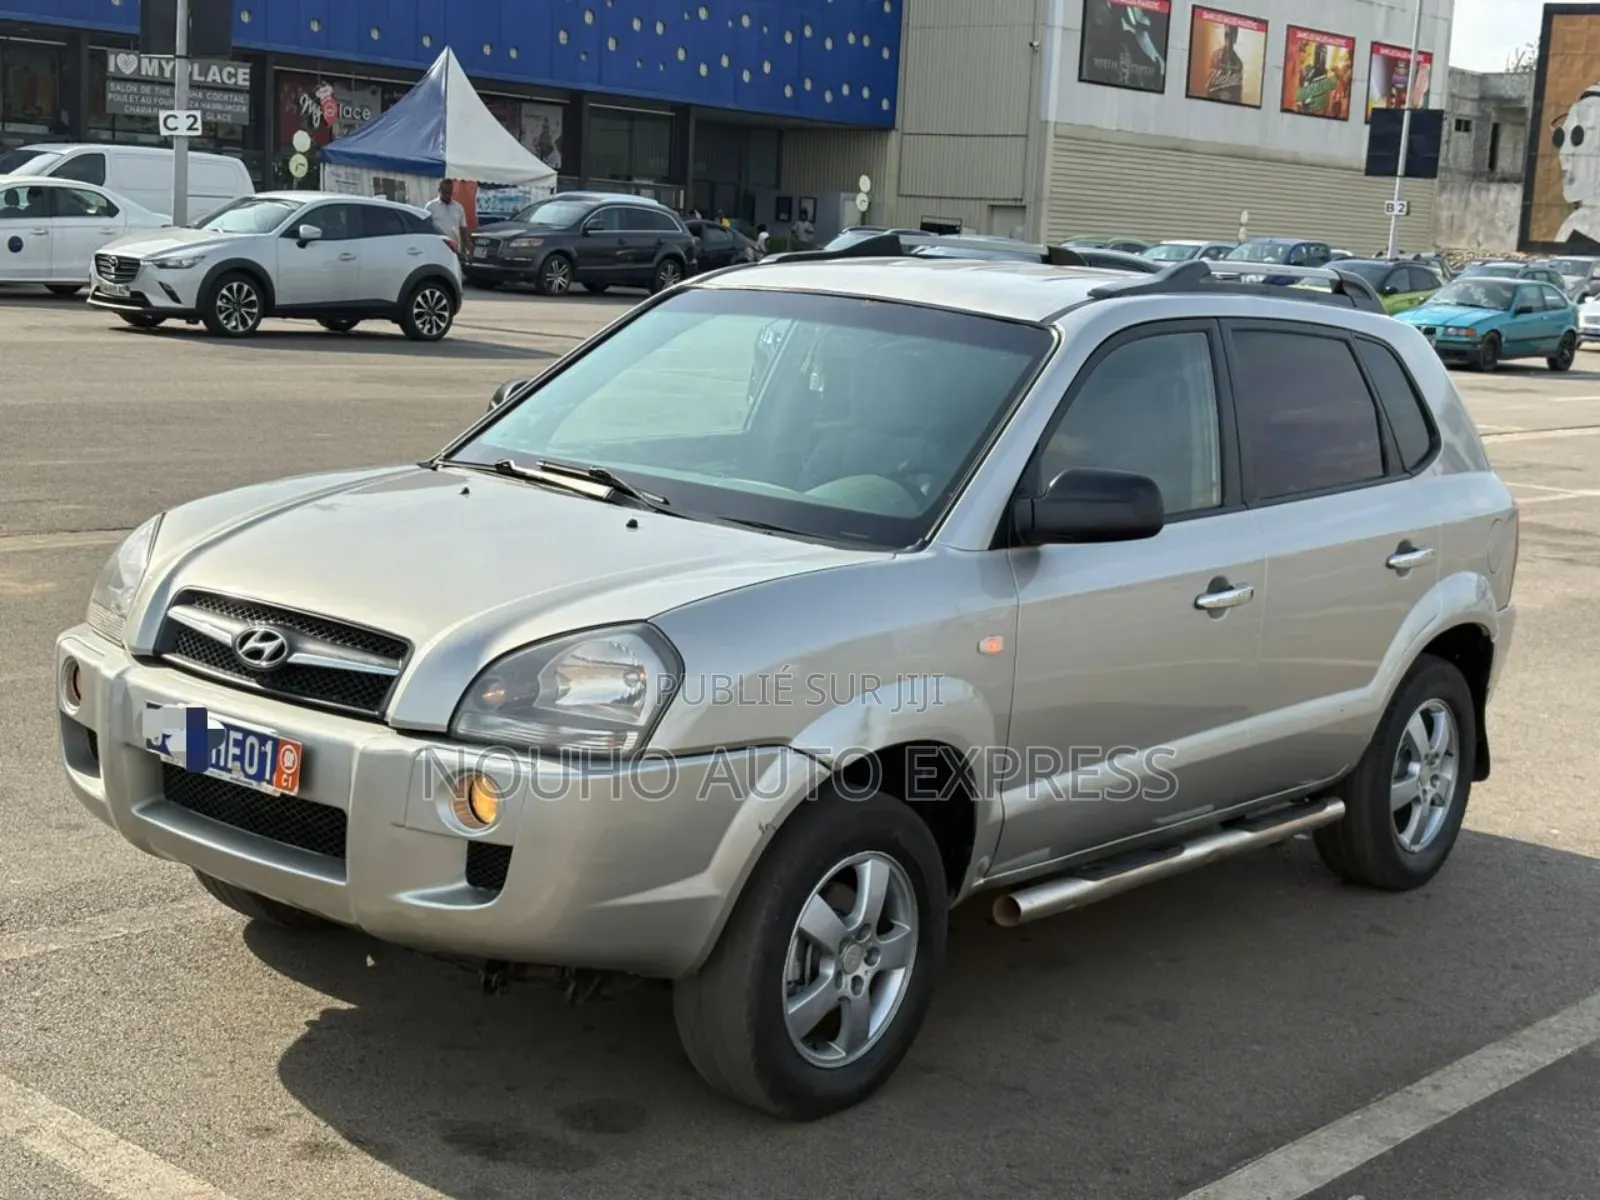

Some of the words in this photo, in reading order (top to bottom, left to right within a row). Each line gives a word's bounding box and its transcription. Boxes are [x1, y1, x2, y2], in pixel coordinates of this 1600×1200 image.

[140, 58, 175, 78] MY
[187, 63, 250, 86] LACE
[109, 82, 137, 92] SALON
[140, 85, 151, 95] DE
[108, 92, 139, 104] POULET
[140, 95, 152, 105] AU
[154, 97, 175, 106] FOUR
[300, 94, 322, 128] My
[163, 114, 179, 131] C
[186, 114, 199, 131] 2
[1386, 203, 1395, 213] B
[1398, 203, 1405, 213] 2
